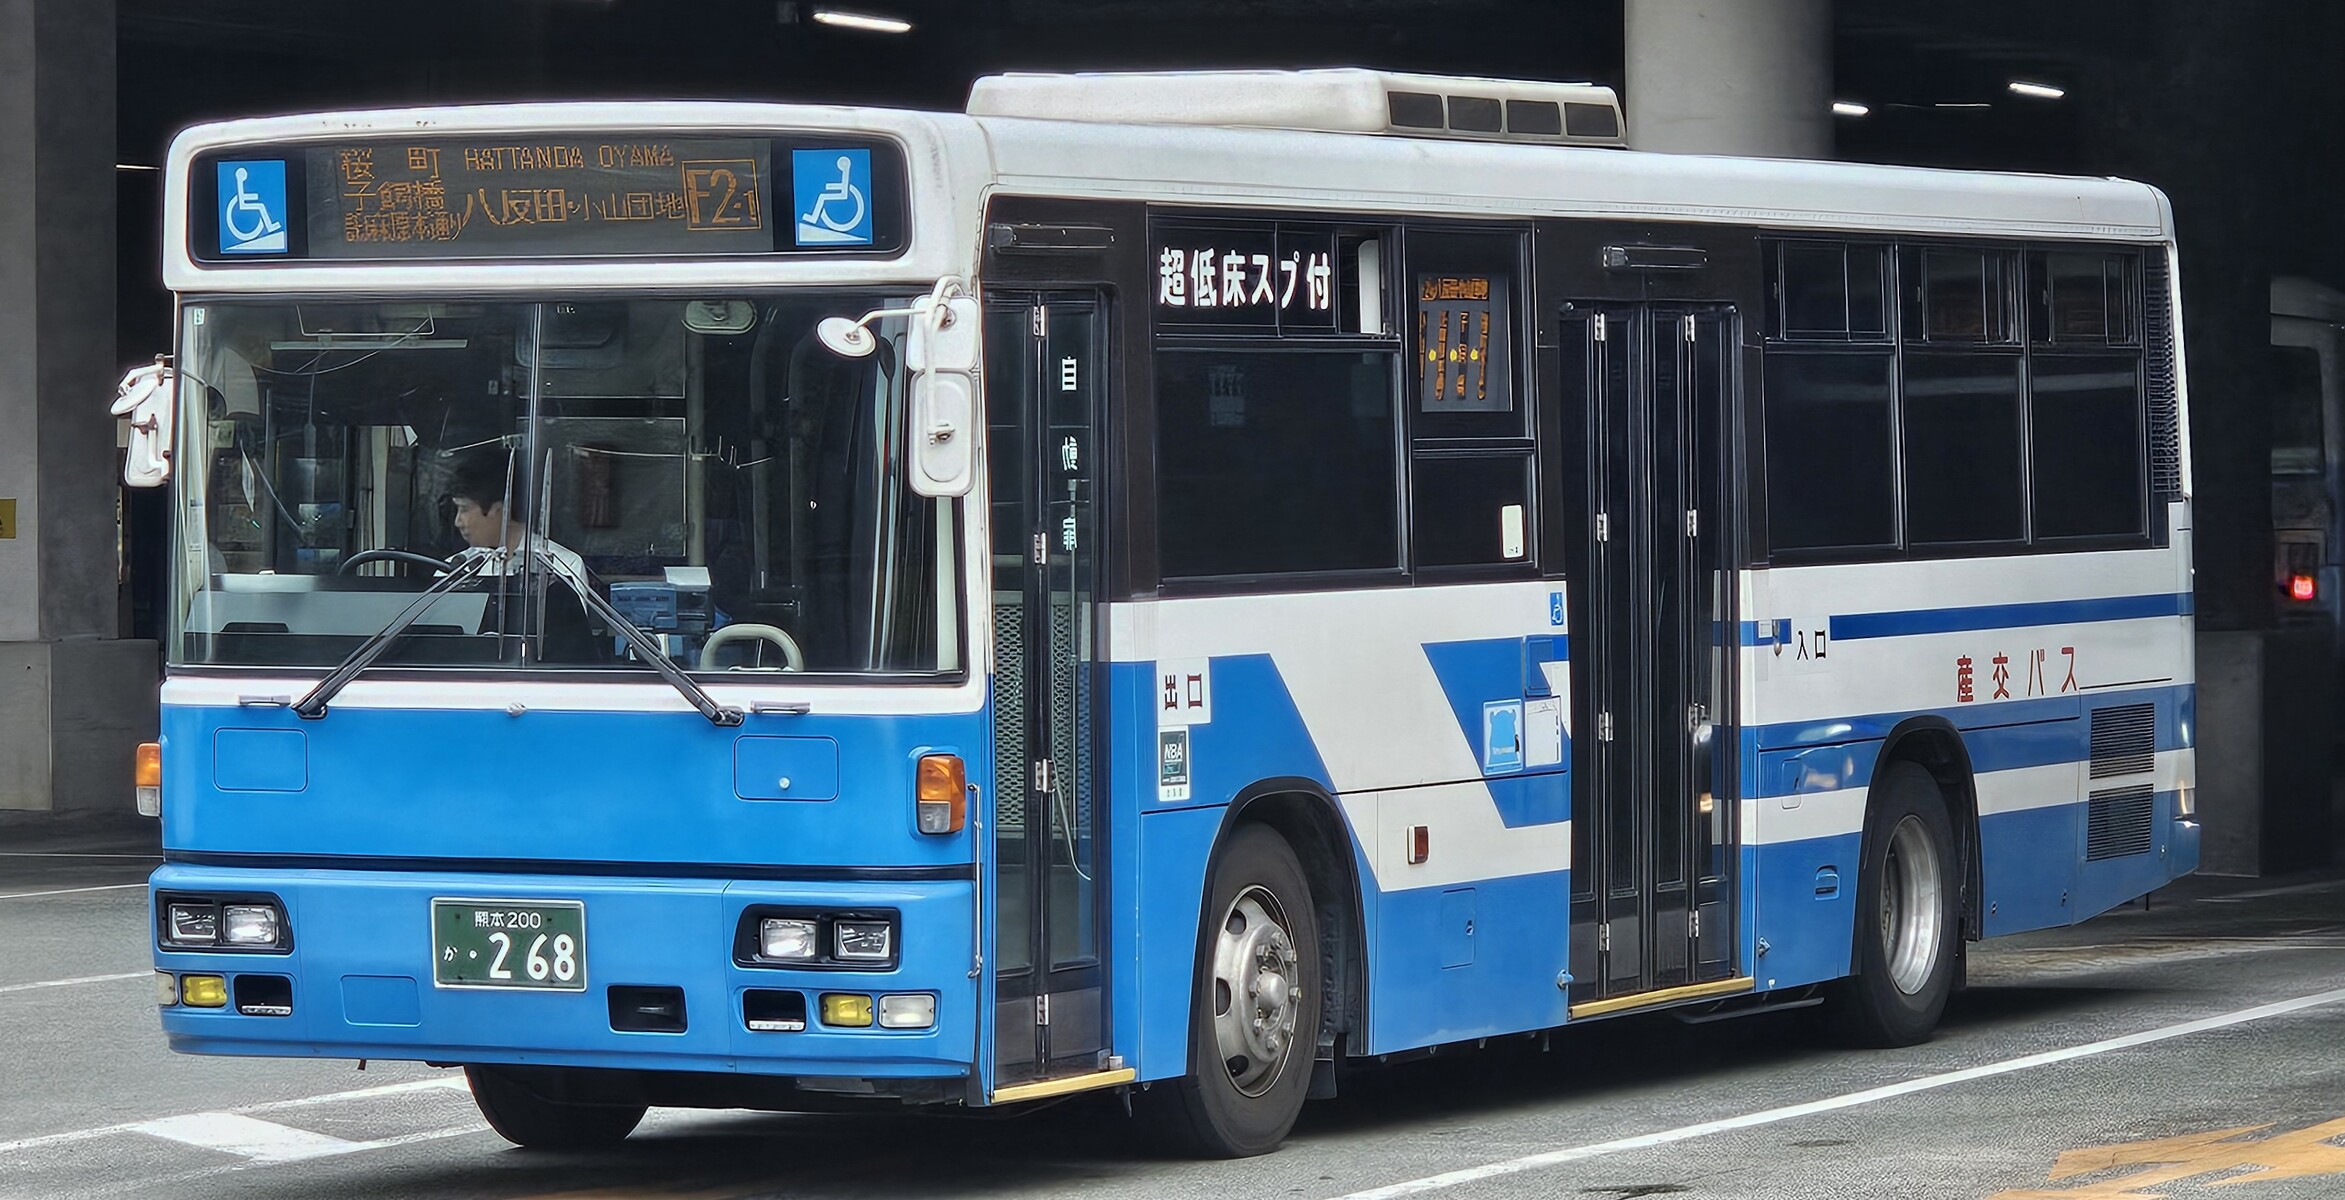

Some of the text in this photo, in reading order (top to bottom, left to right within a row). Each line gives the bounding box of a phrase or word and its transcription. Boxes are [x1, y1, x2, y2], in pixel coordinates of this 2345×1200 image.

[464, 144, 674, 170] HATTANDA OYAMA
[1159, 246, 1332, 311] 超低床スプ付
[1796, 629, 1827, 661] 入口
[1164, 673, 1203, 710] 出口
[1956, 646, 2078, 703] 産交バス
